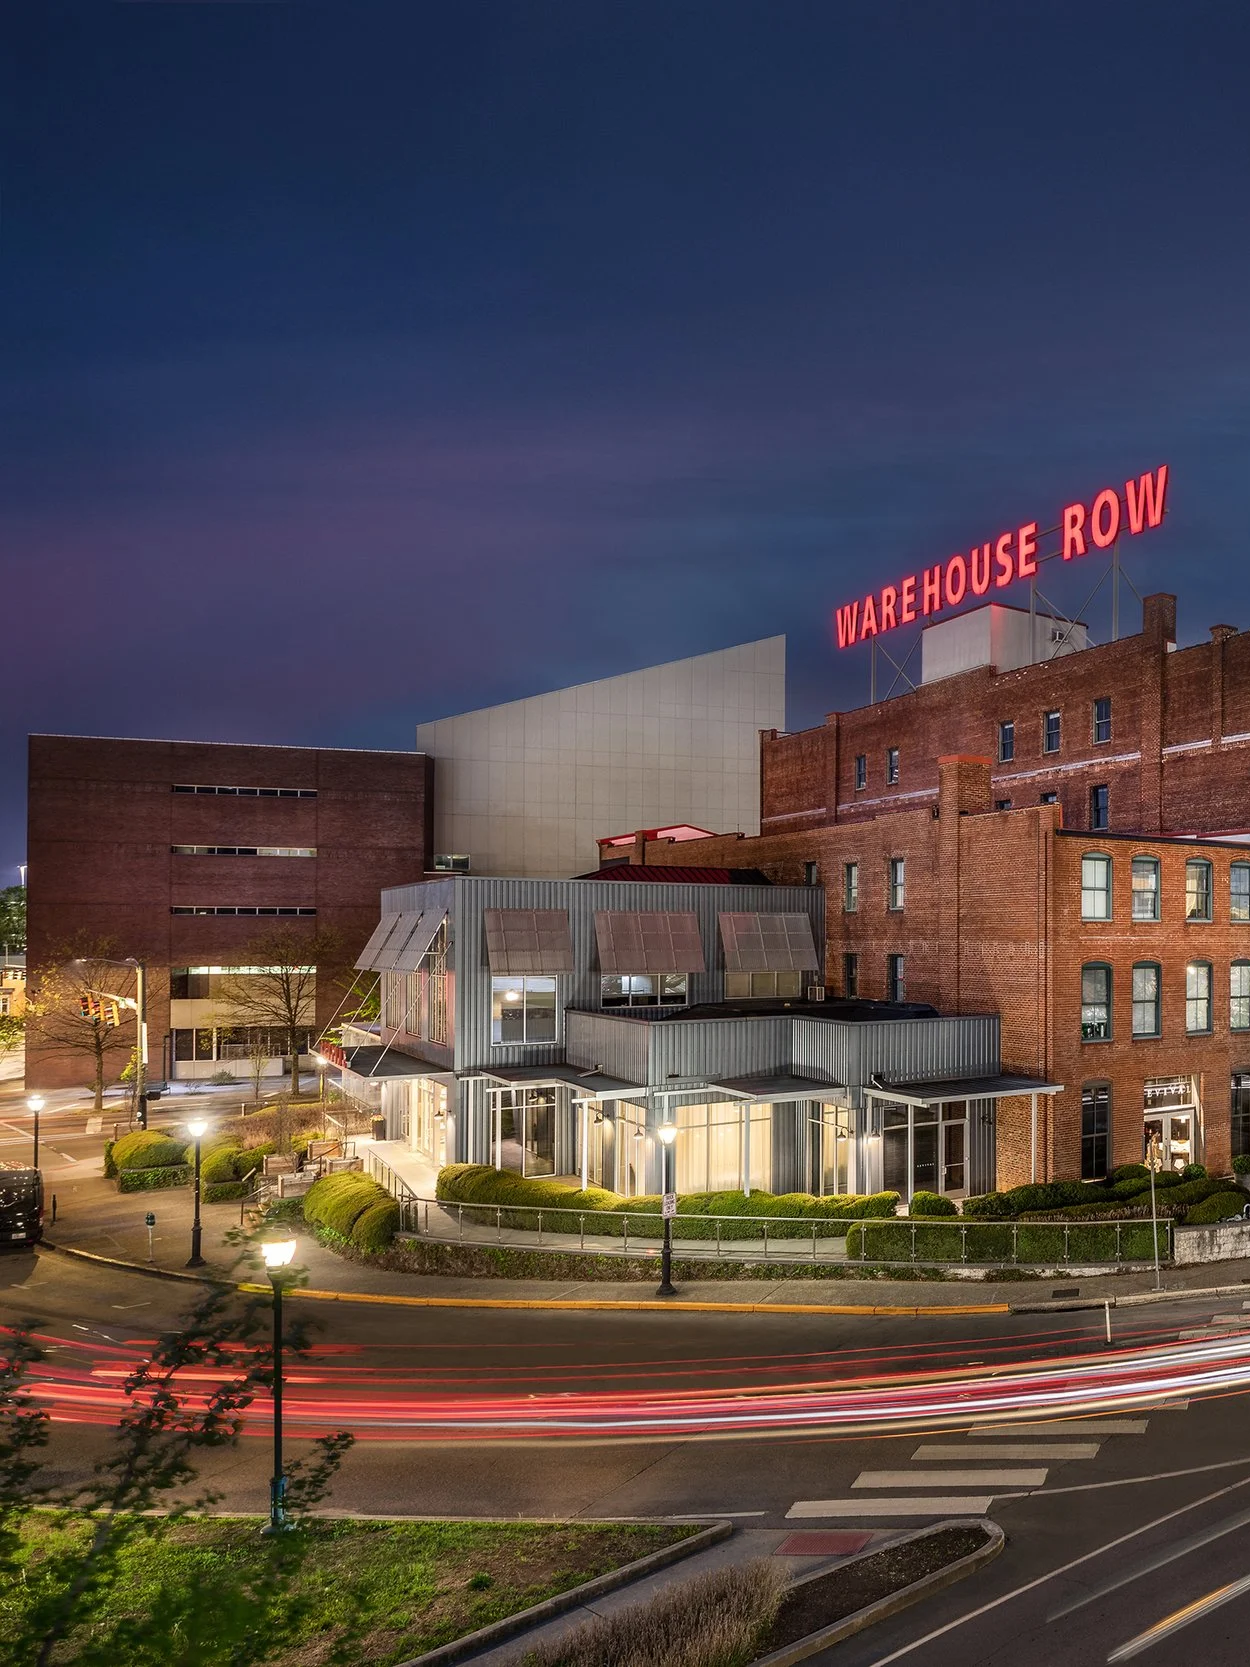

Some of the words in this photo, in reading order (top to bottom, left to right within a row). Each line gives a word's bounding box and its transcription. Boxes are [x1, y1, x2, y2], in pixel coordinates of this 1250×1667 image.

[836, 522, 1038, 649] WAREHOUSE
[1062, 464, 1168, 561] ROW
[1146, 1084, 1191, 1098] EVIVAL
